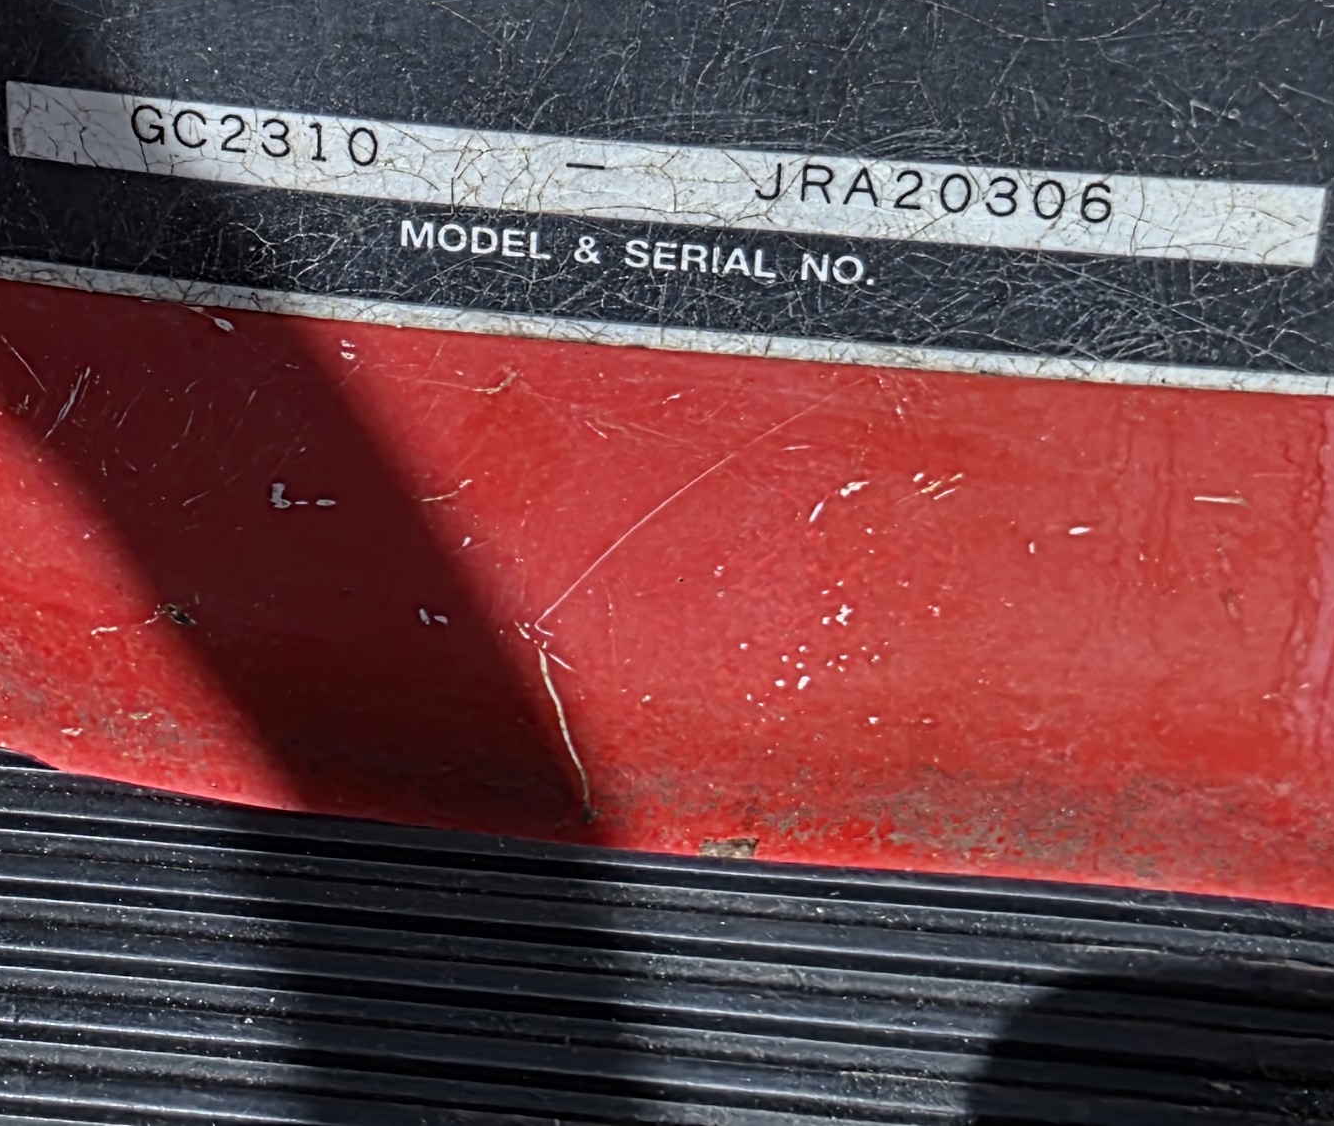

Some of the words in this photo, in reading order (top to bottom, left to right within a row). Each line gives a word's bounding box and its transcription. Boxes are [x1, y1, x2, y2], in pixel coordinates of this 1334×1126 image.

[130, 104, 379, 167] GC2310
[754, 162, 1114, 224] JRA20306
[400, 220, 551, 261] MODEL
[573, 236, 601, 264] &
[624, 240, 776, 278] SERIAL
[799, 252, 875, 286] NO.
